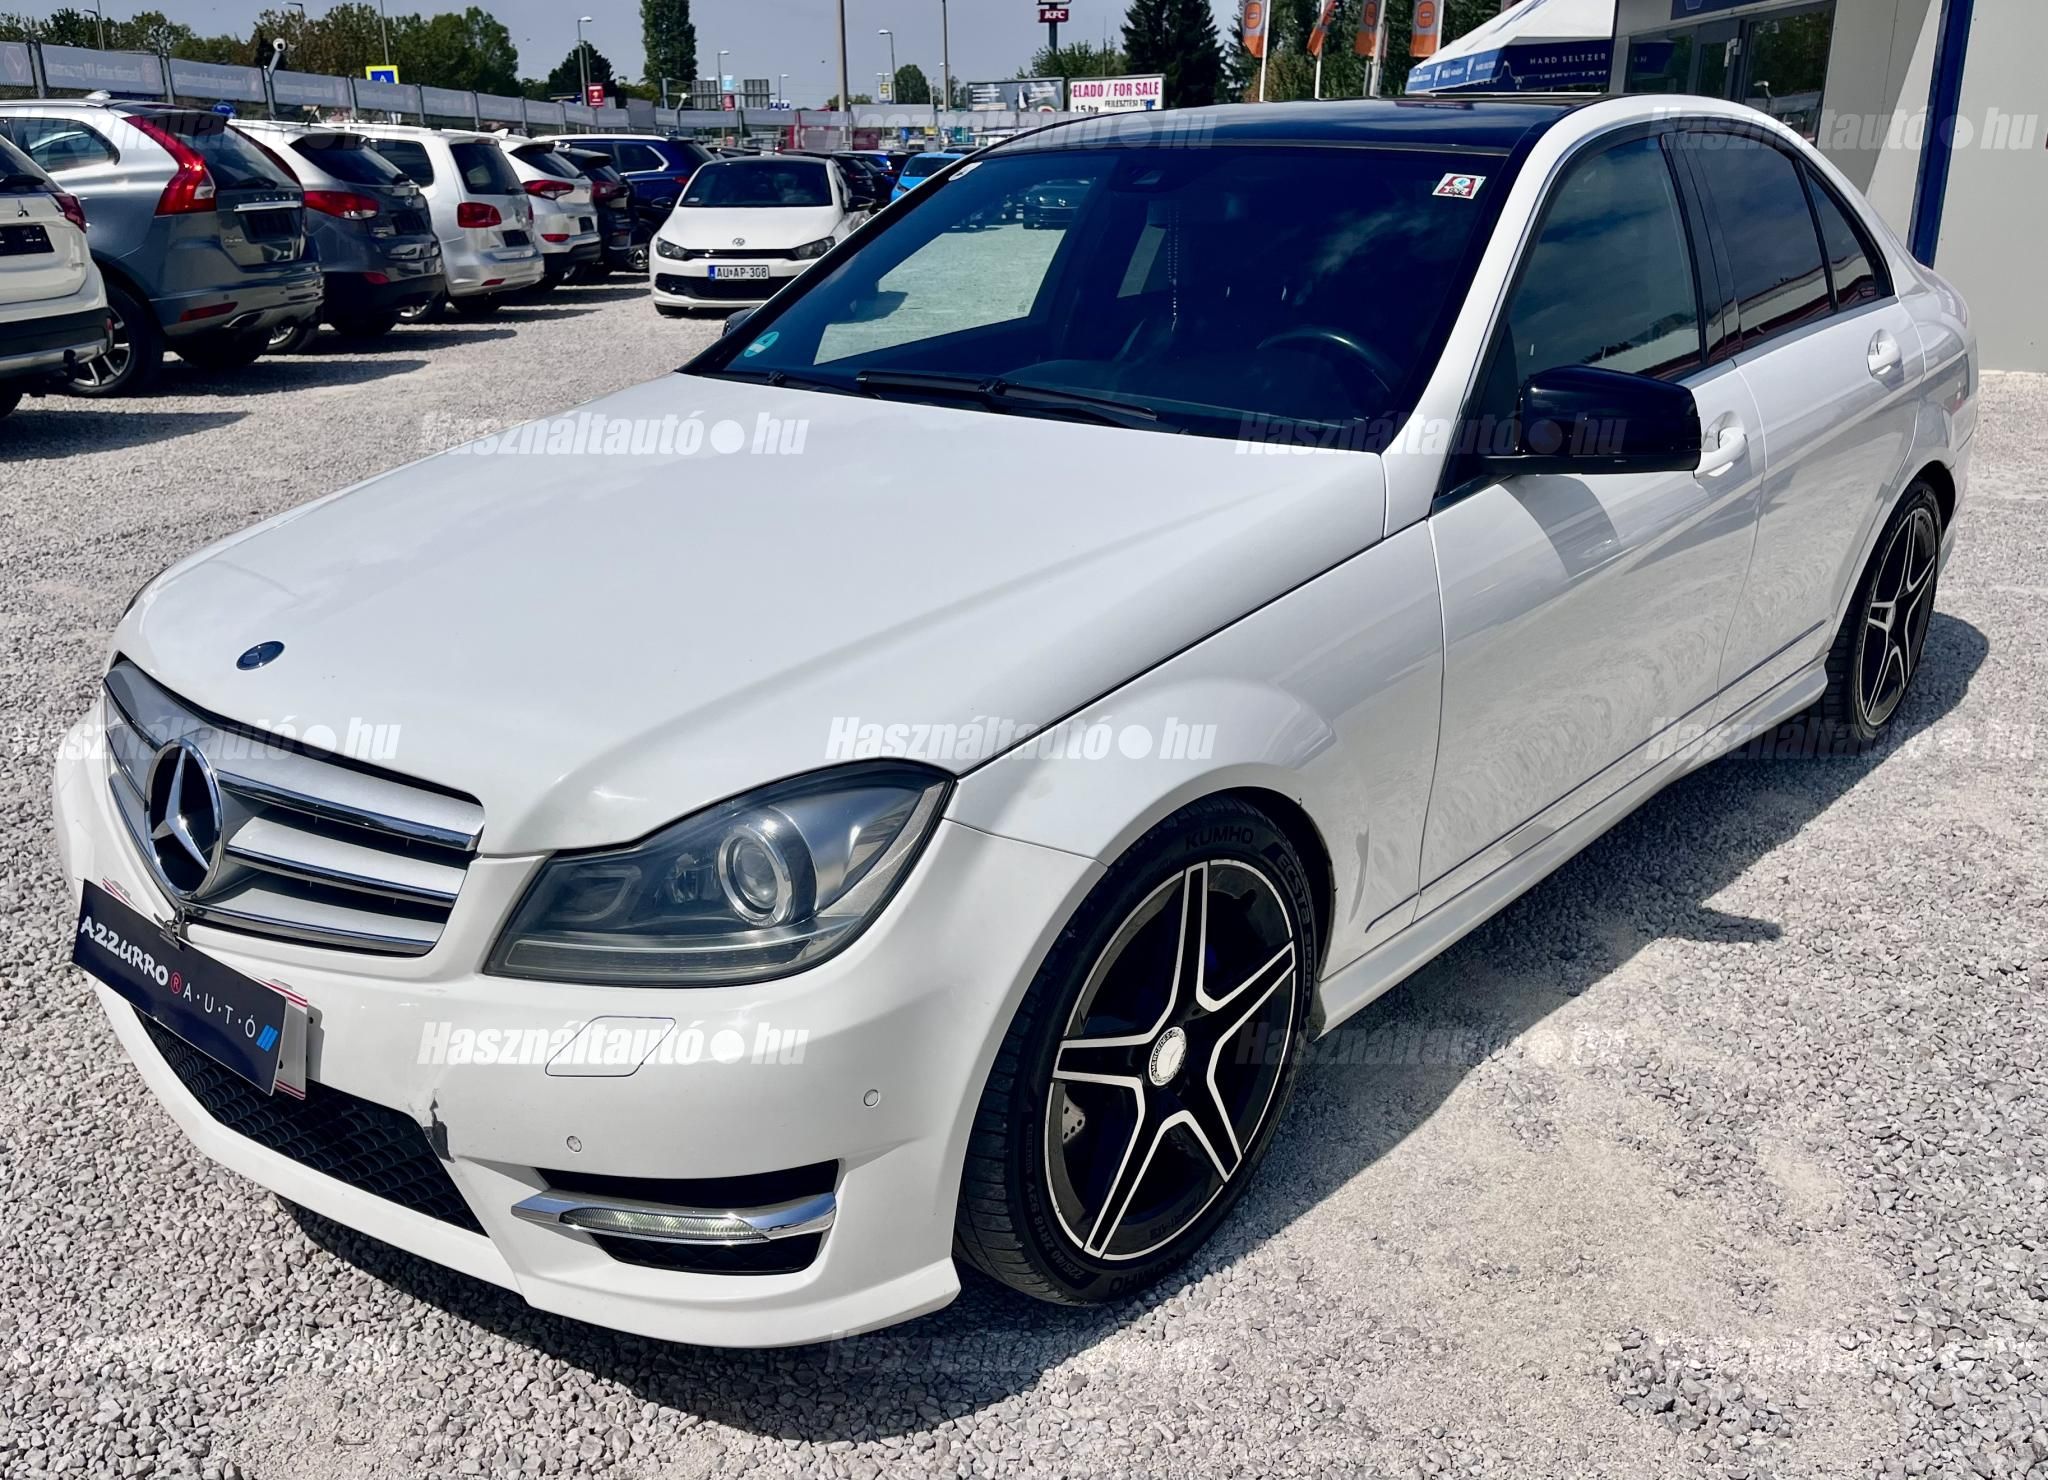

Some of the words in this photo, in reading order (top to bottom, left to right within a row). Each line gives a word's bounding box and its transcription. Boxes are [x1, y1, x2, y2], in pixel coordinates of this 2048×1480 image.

[1044, 10, 1065, 19] KFC
[1529, 57, 1558, 65] HARD
[1562, 53, 1606, 63] SELTZER
[1113, 83, 1133, 97] FOR
[1135, 81, 1159, 96] SALE
[1185, 825, 1255, 850] KUMHO
[1303, 931, 1313, 1001] SPORT
